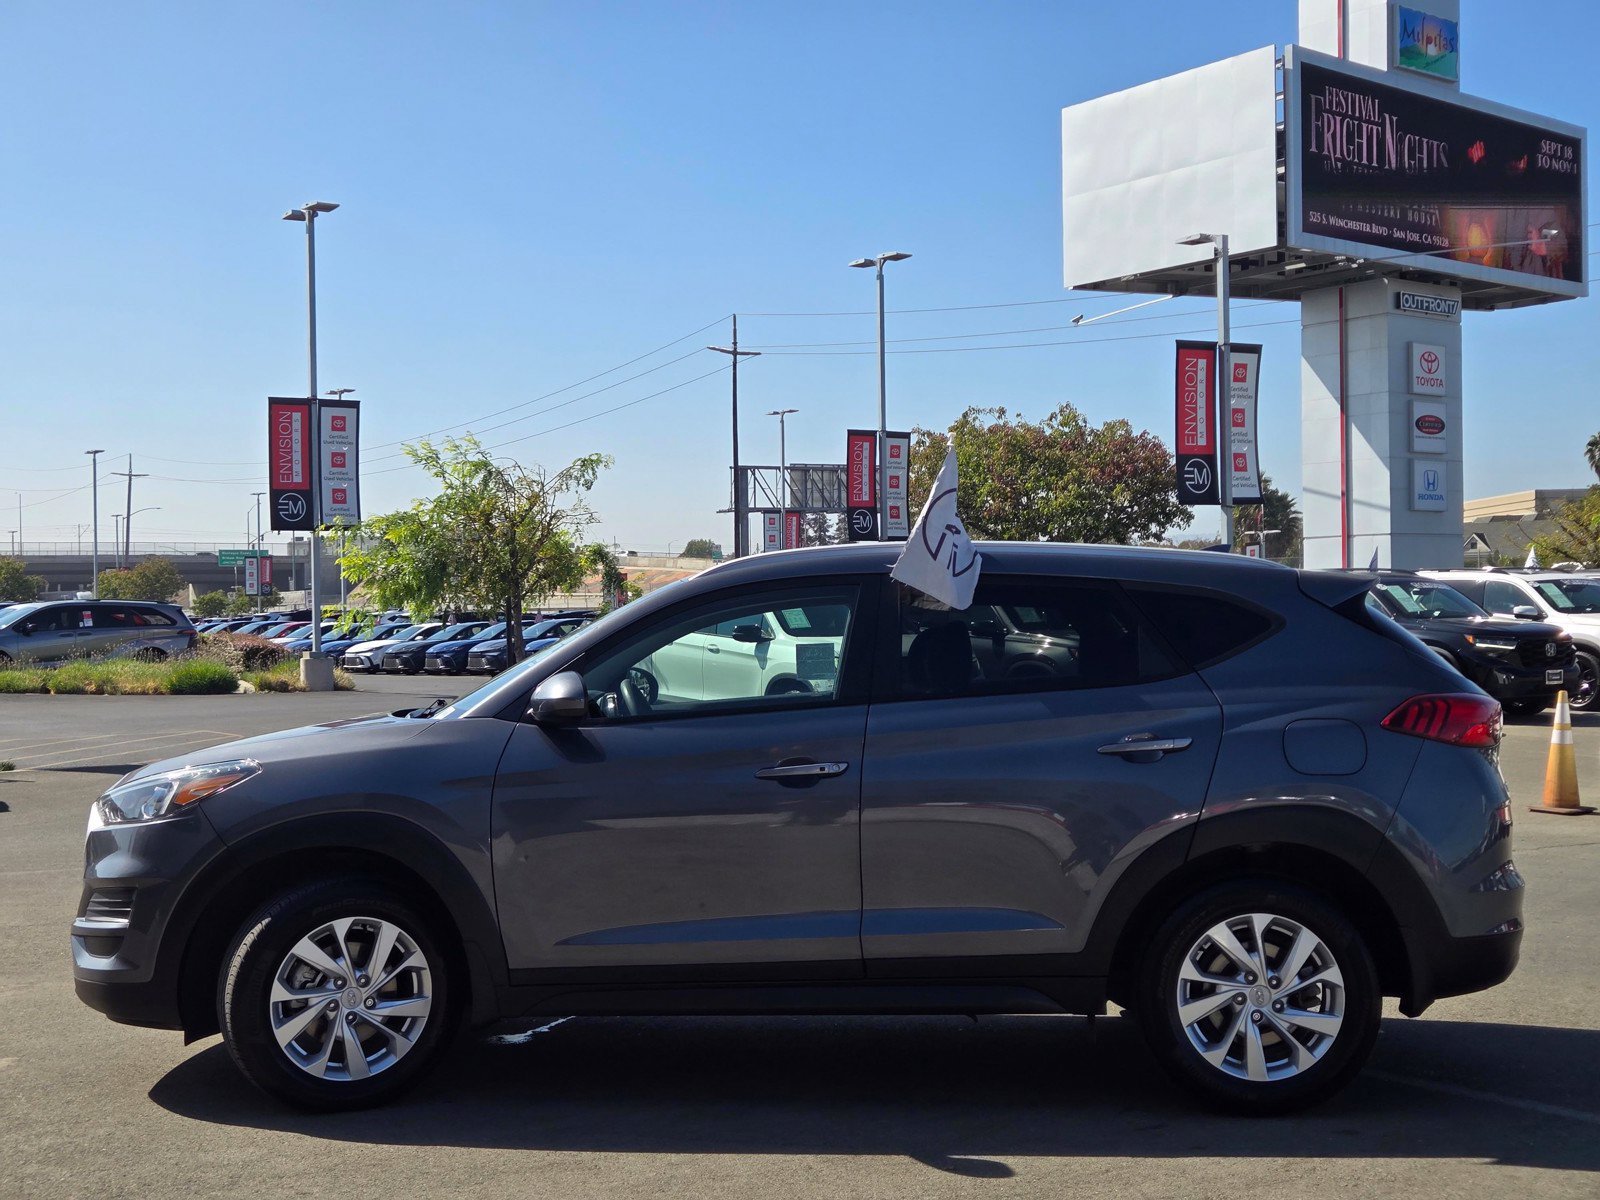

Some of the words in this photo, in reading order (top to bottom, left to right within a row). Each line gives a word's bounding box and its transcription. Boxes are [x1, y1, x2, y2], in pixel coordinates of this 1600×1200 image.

[1401, 13, 1454, 57] Milpitas
[1325, 85, 1381, 123] FESTIVAL
[1309, 94, 1381, 168] FRIGHT
[1384, 113, 1449, 172] NIGHTS
[1541, 139, 1562, 157] SEPT
[1564, 145, 1573, 159] 18
[1536, 153, 1550, 168] TO
[1552, 158, 1572, 173] NOV
[1309, 211, 1321, 223] 525
[1322, 214, 1328, 225] S.
[1328, 215, 1371, 233] WINCHESTER
[1372, 223, 1388, 236] BLVD
[1393, 228, 1405, 239] SAN
[1406, 230, 1422, 243] JOSE,
[1422, 233, 1433, 246] CA
[1433, 235, 1449, 248] 95128
[1416, 376, 1444, 388] TOYOTA
[1185, 358, 1197, 445] ENVISION
[279, 411, 291, 483] ENVISION
[853, 441, 862, 500] ENVISION
[1418, 493, 1444, 501] HONDA
